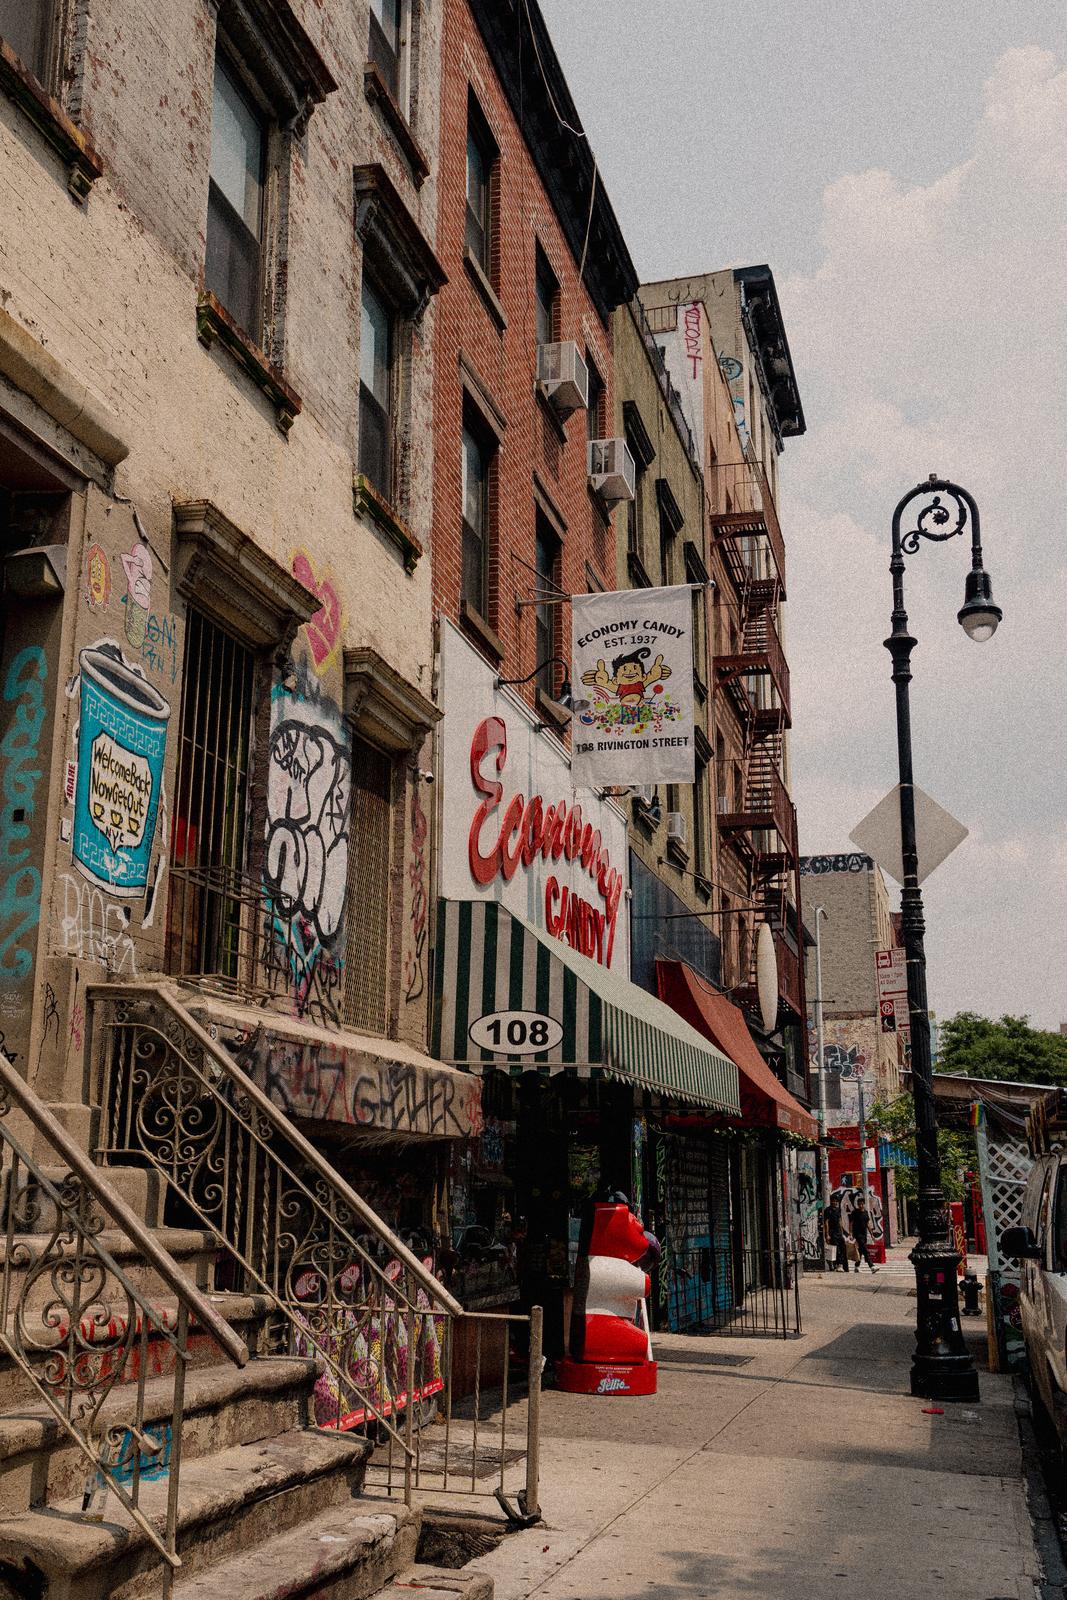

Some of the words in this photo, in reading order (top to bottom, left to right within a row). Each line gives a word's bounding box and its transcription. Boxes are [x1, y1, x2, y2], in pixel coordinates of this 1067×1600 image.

[577, 620, 638, 648] ECONOMY
[643, 620, 685, 639] CANDY
[604, 637, 627, 648] EST.
[631, 635, 658, 645] 1937
[597, 739, 649, 751] RIVINGTON
[652, 737, 689, 747] STREET
[546, 876, 606, 965] CANDY
[487, 1019, 549, 1046] 108
